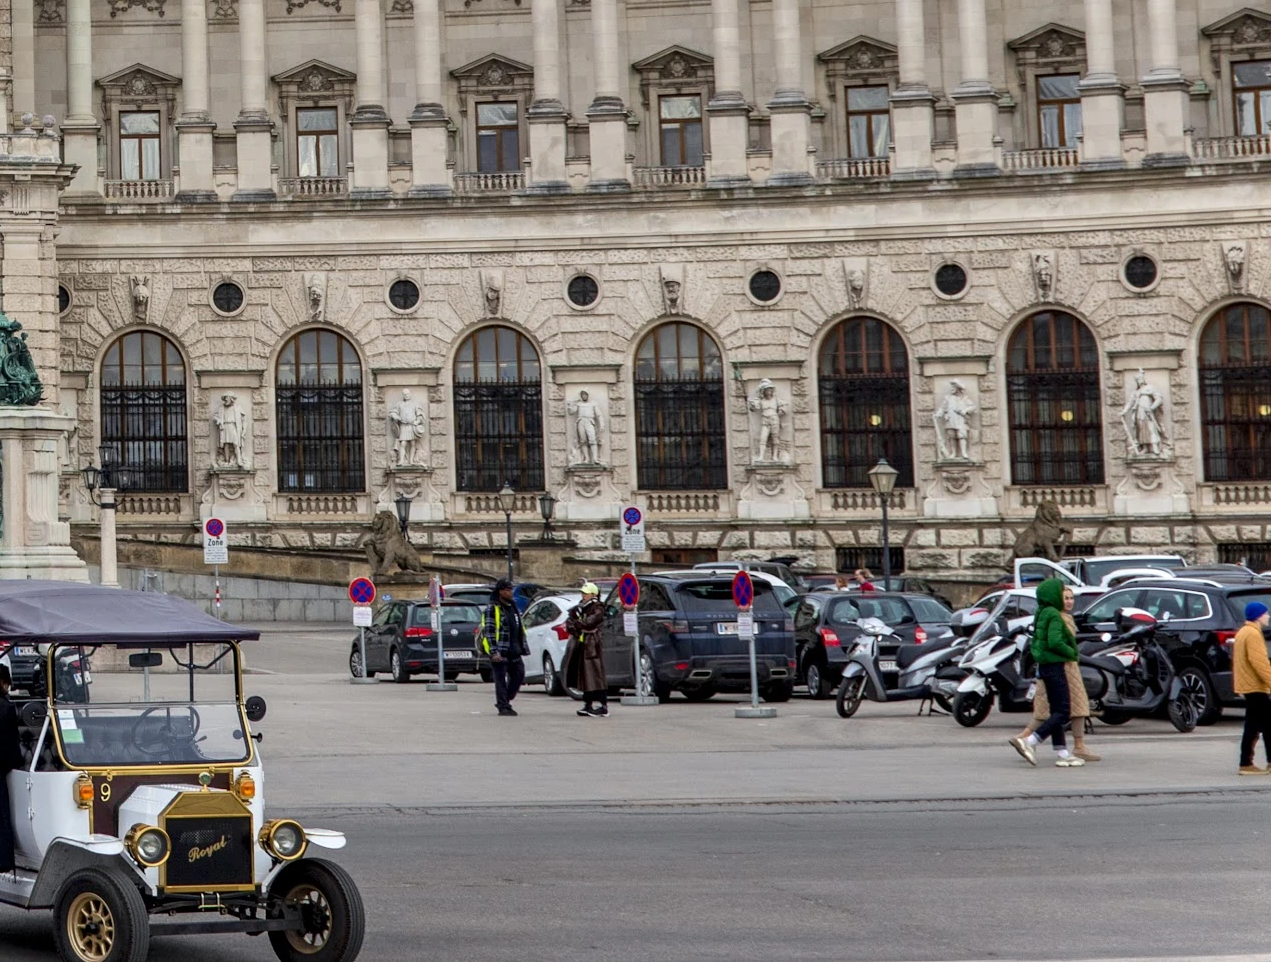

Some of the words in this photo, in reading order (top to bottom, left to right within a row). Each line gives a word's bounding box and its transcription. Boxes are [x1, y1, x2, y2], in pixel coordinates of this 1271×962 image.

[207, 538, 224, 547] Zone
[100, 783, 111, 802] 9
[188, 835, 228, 863] Royal
